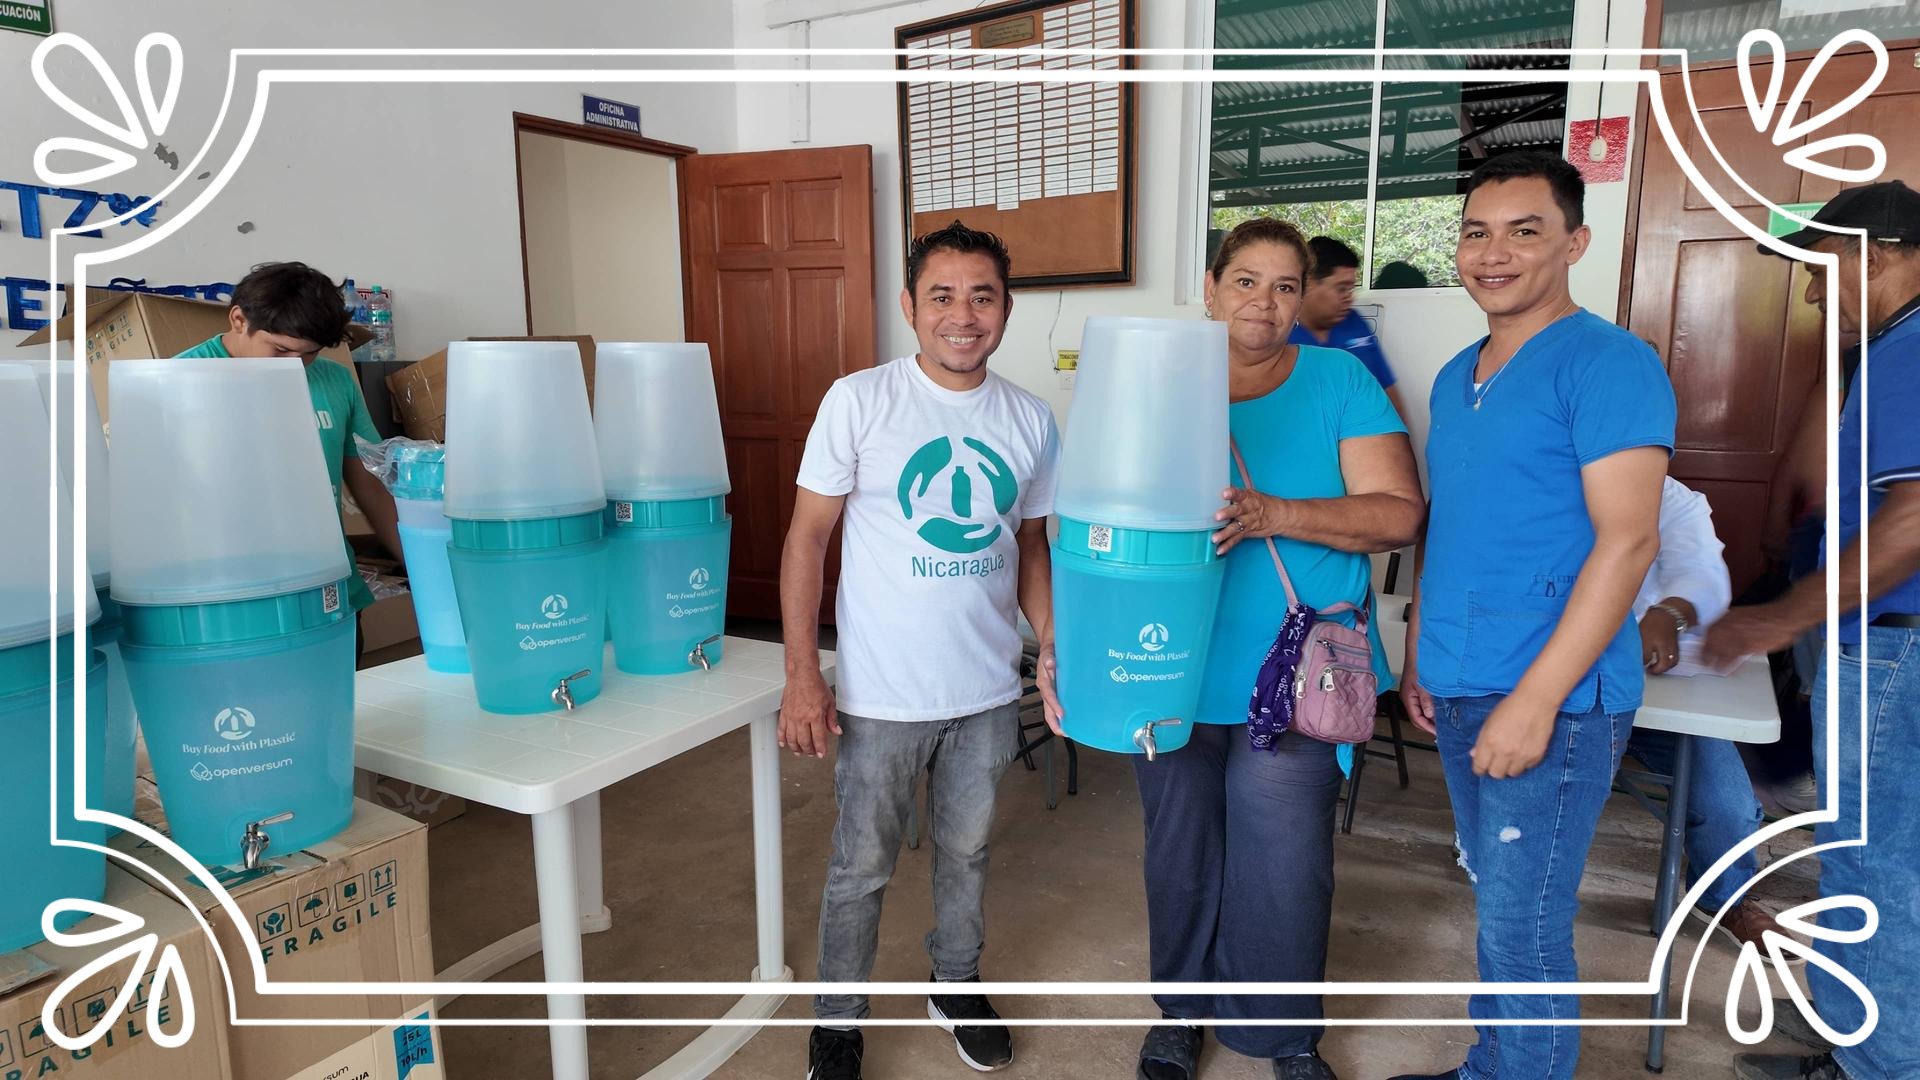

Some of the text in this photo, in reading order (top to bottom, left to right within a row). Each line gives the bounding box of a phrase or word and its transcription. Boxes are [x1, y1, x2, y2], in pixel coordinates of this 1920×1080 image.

[599, 101, 625, 117] OFICINA
[586, 111, 639, 132] ADMINISTRATIVA
[0, 180, 104, 240] TZ
[911, 553, 1005, 578] Nicaragua
[515, 622, 530, 632] Buy
[531, 621, 551, 630] Food
[552, 618, 568, 628] with
[537, 632, 587, 648] openversum
[1108, 648, 1124, 661] Buy
[1126, 651, 1148, 662] Food
[1148, 652, 1166, 661] with
[1129, 671, 1185, 683] openversum
[182, 732, 296, 756] Buy Food with Plastic
[213, 757, 293, 778] openversum
[261, 892, 397, 965] FRAGILE
